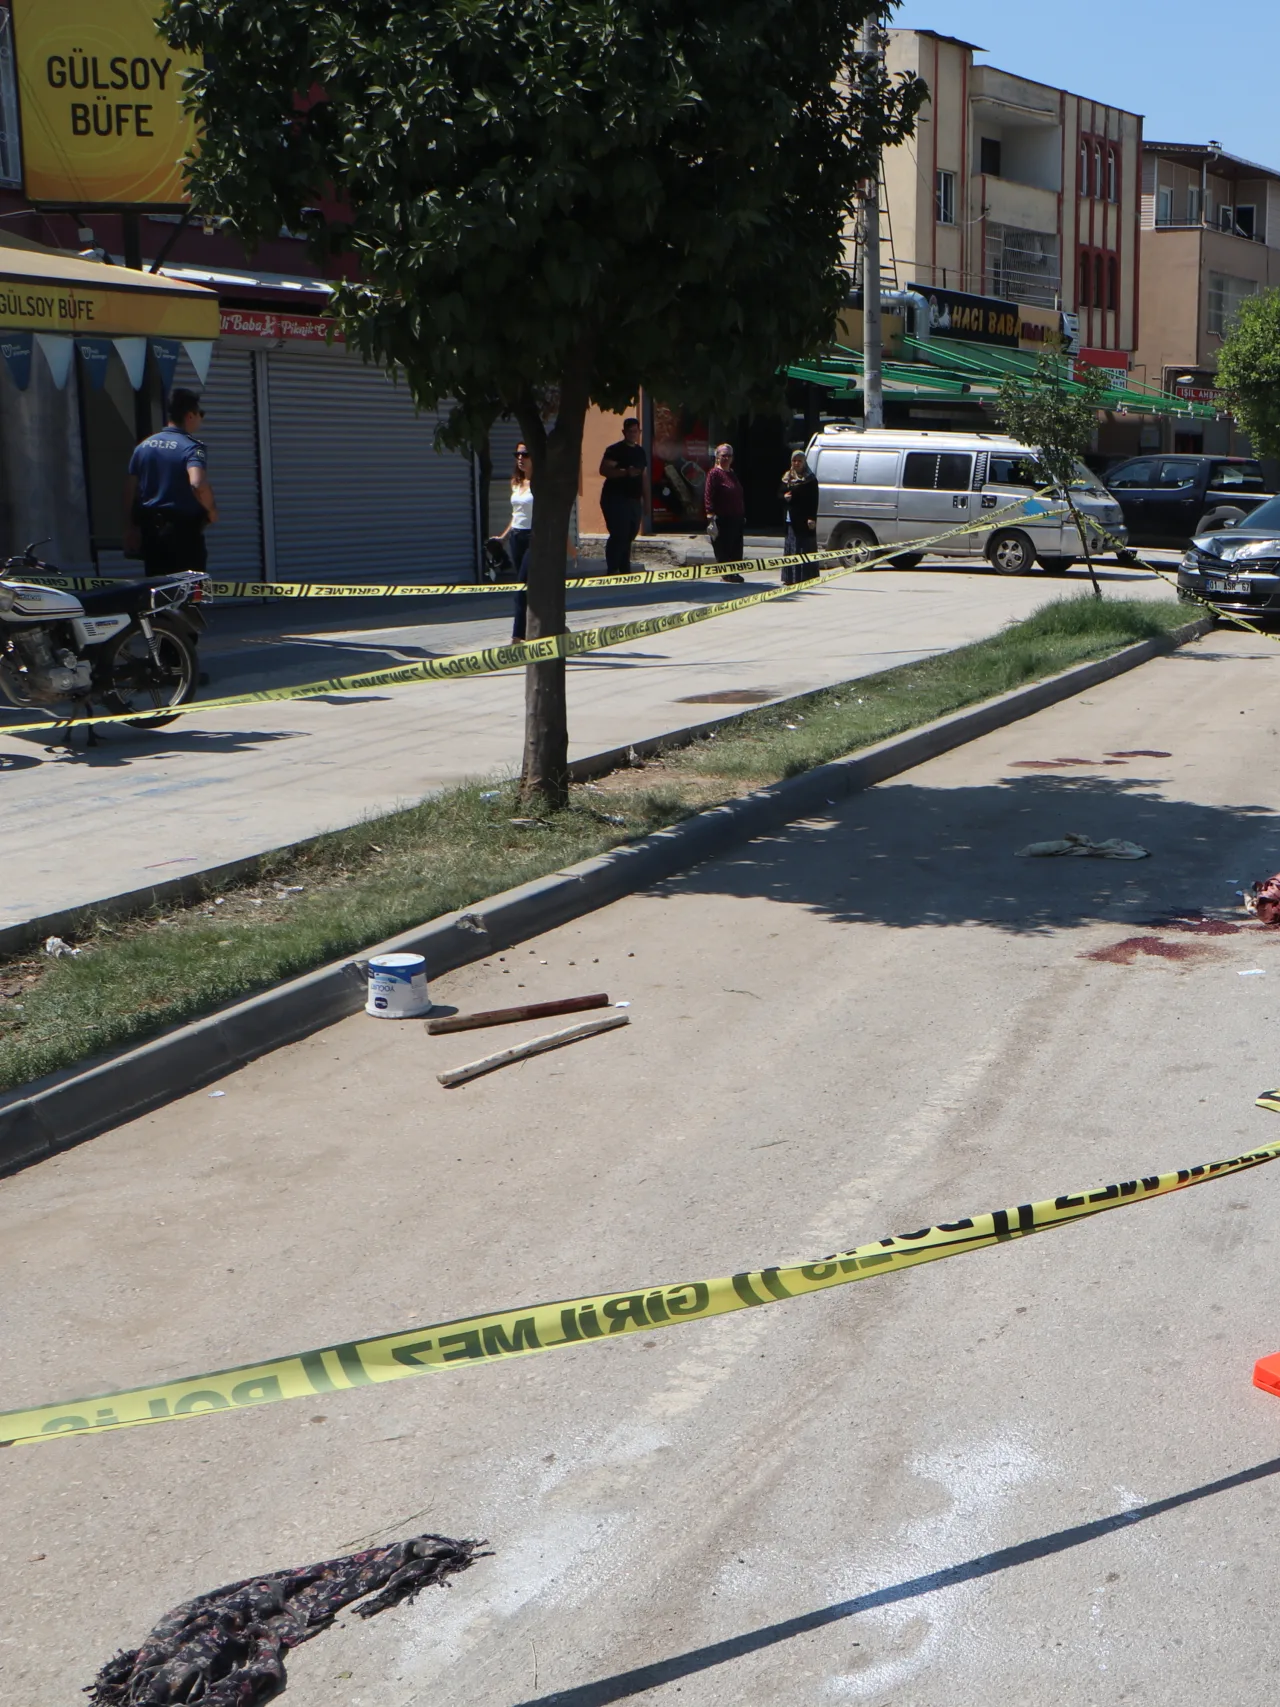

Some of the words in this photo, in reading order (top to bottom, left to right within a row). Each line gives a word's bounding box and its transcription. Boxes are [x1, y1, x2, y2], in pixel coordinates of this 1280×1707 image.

[47, 48, 172, 91] GÜLSOY
[71, 95, 154, 137] BÜFE
[0, 289, 54, 318] GÜLSOY
[59, 294, 95, 320] BÜFE
[230, 314, 262, 331] Baba
[952, 305, 983, 332] HACI
[988, 311, 1023, 339] BABA
[142, 439, 178, 449] POLİS
[587, 574, 641, 587] GİRİLMEZ
[657, 568, 690, 580] POLİS
[704, 561, 754, 576] GİRİLMEZ
[768, 556, 799, 568] POLİS
[1224, 580, 1236, 591] ASR
[251, 585, 294, 595] POLİS
[314, 586, 380, 596] GİRİLMEZ
